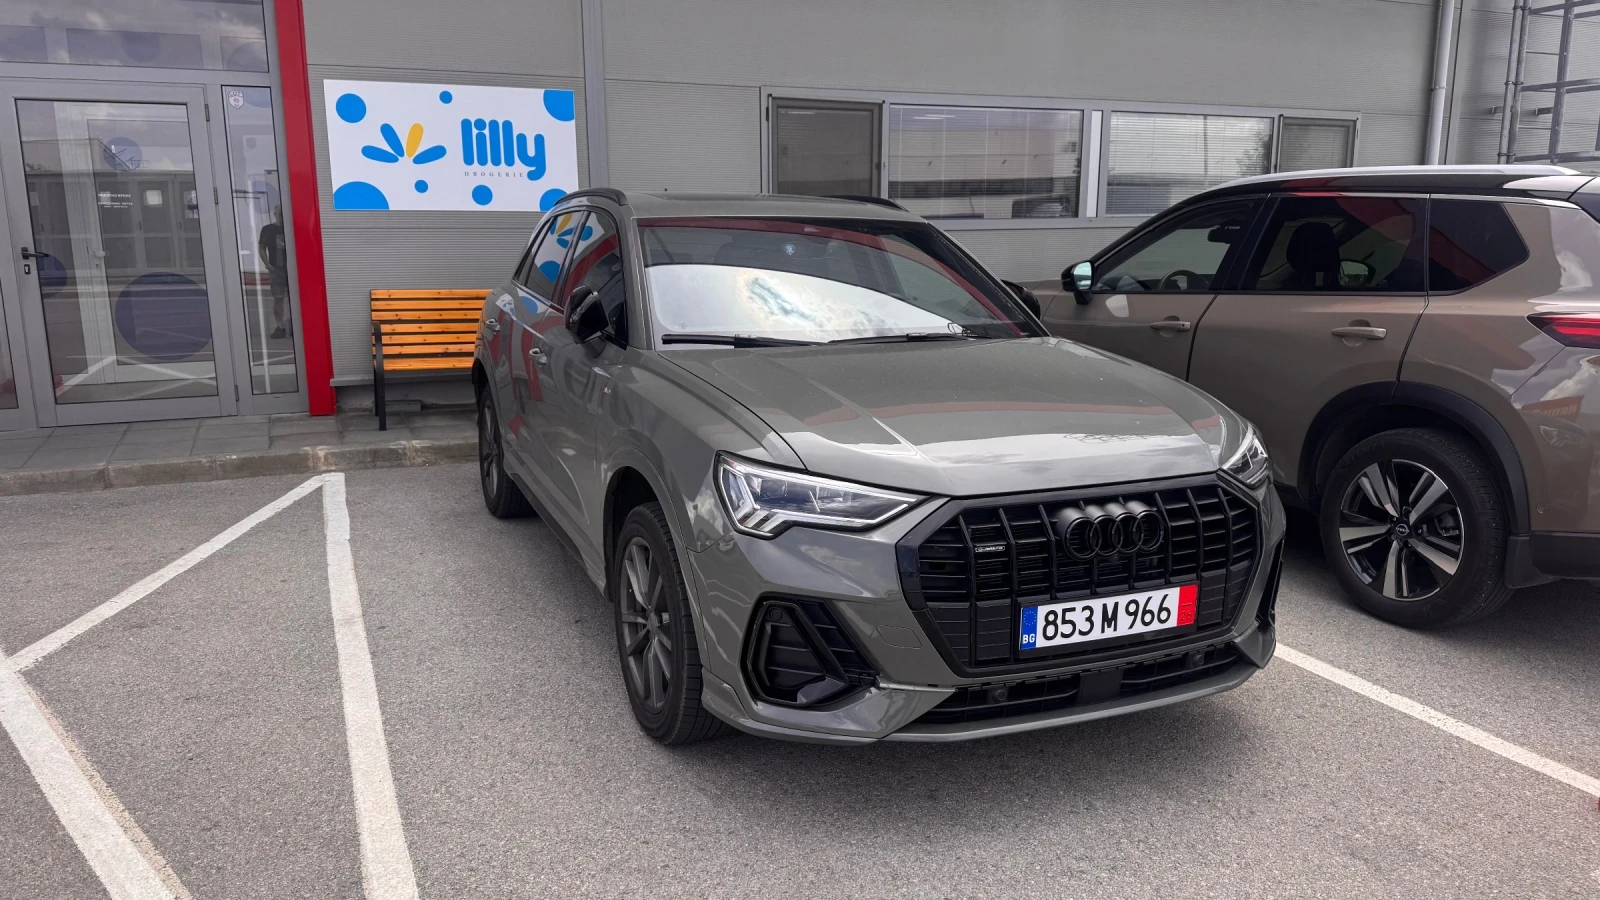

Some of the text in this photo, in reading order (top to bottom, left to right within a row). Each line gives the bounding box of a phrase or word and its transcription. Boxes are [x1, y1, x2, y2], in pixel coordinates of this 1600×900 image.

[461, 118, 546, 181] lilly
[1022, 633, 1036, 644] BG
[1042, 594, 1171, 641] 853 M 966
